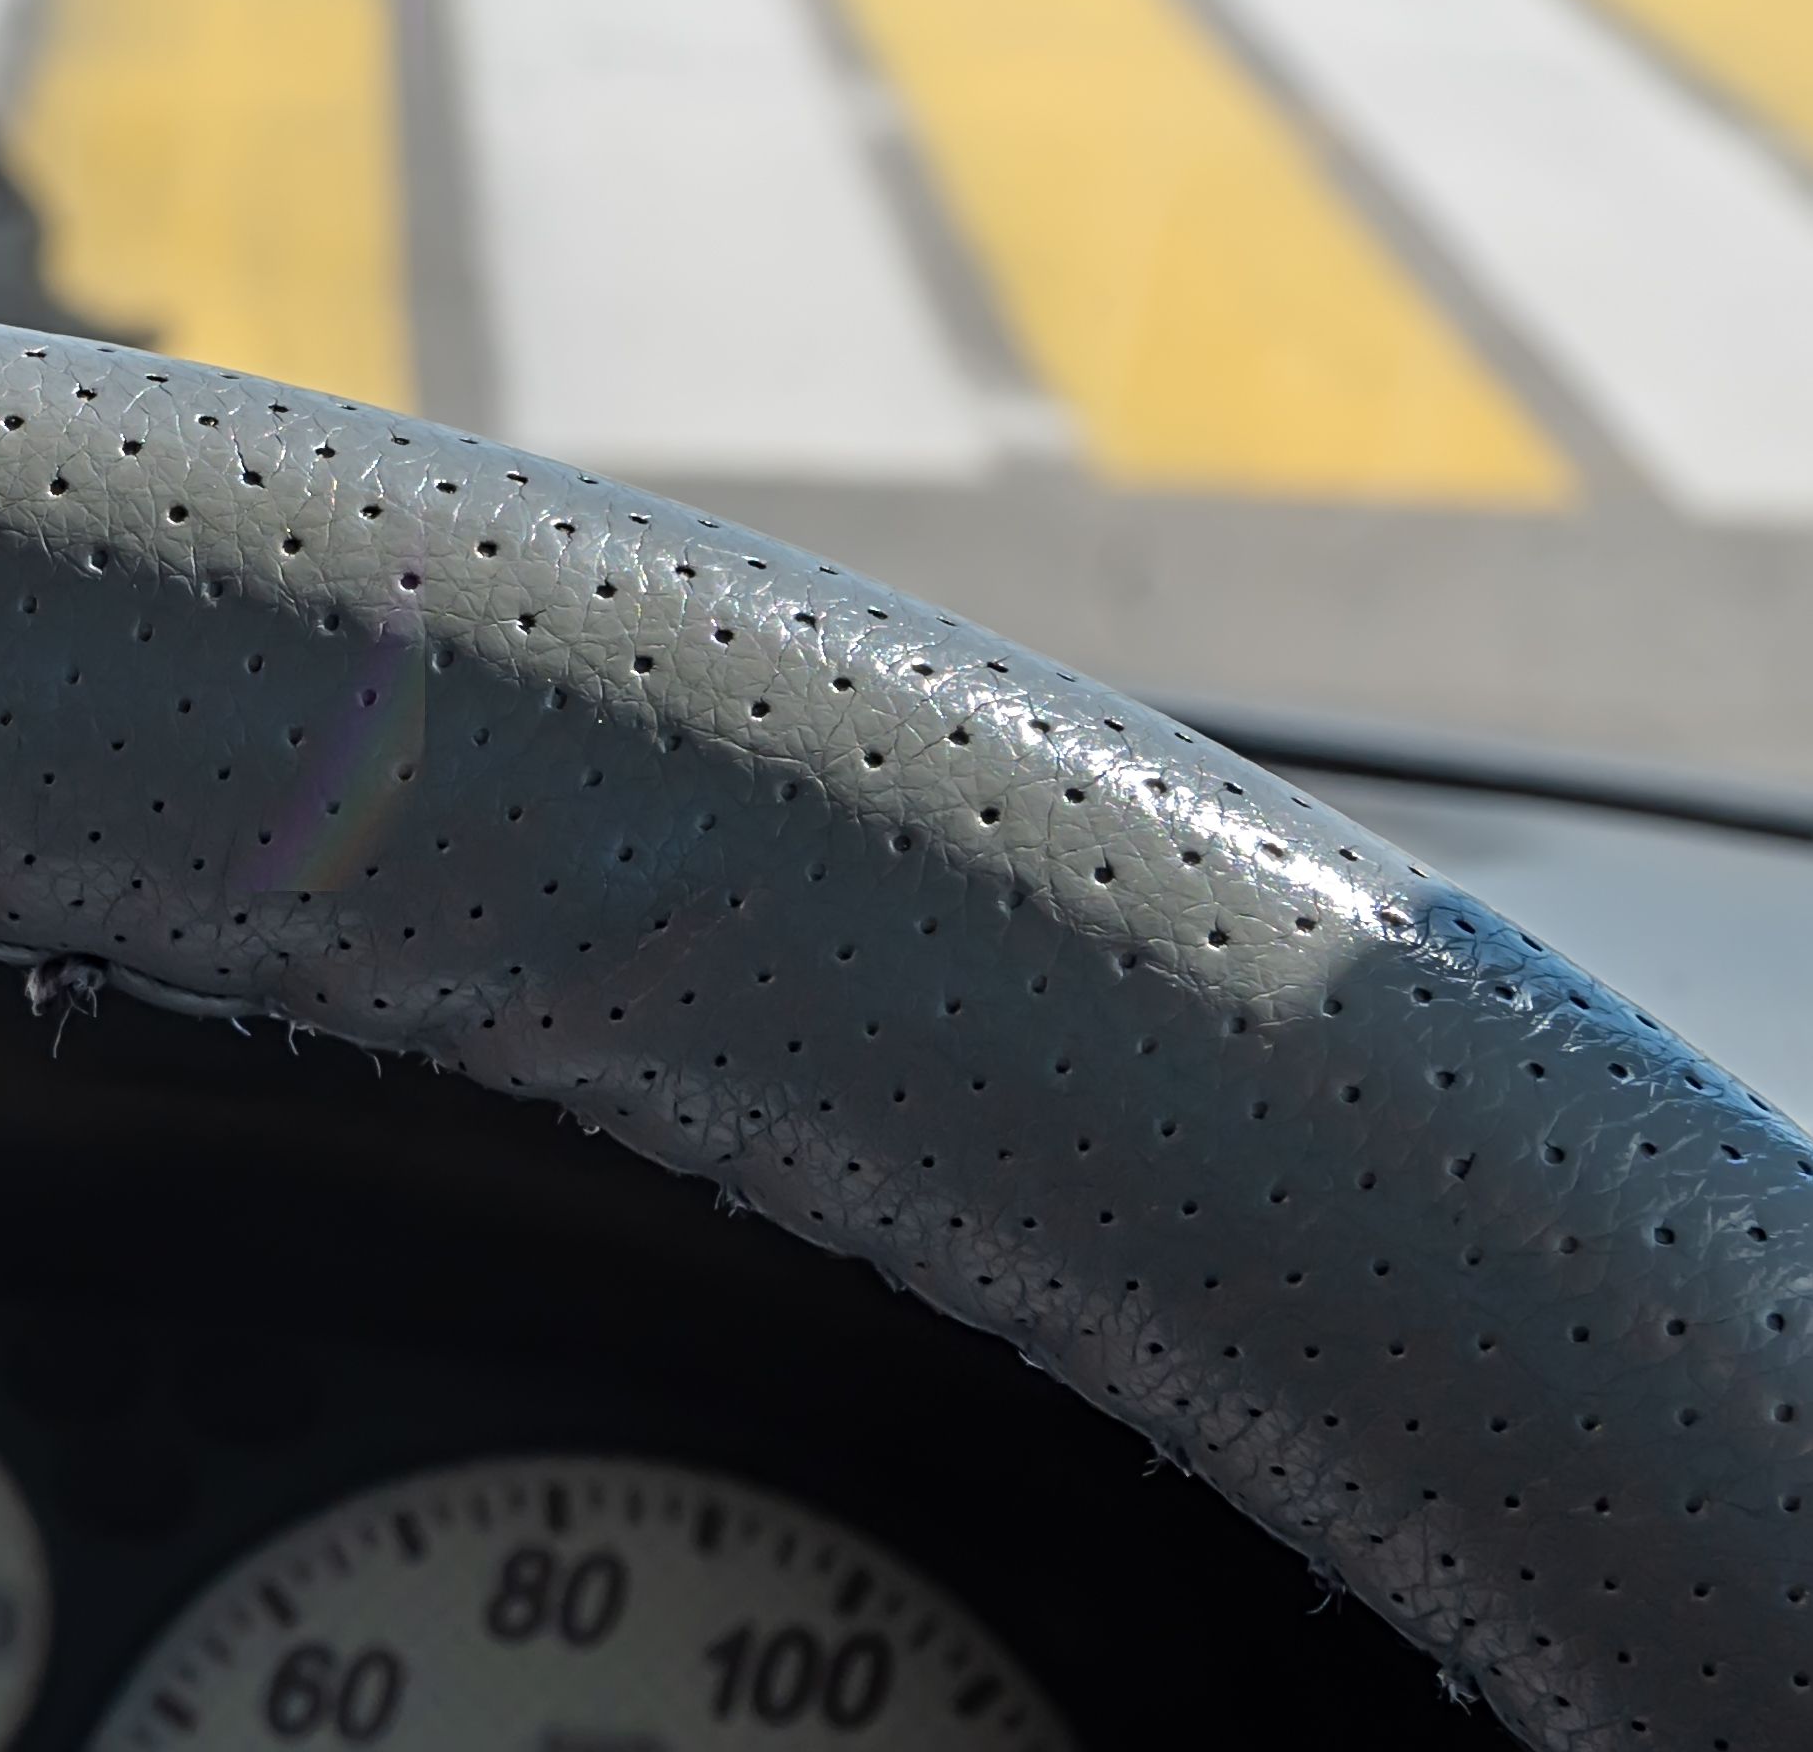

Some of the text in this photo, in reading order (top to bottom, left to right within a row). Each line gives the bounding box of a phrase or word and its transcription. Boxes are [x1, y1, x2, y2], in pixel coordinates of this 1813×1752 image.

[485, 1546, 629, 1646] 80
[263, 1644, 407, 1744] 60
[705, 1624, 895, 1730] 100
